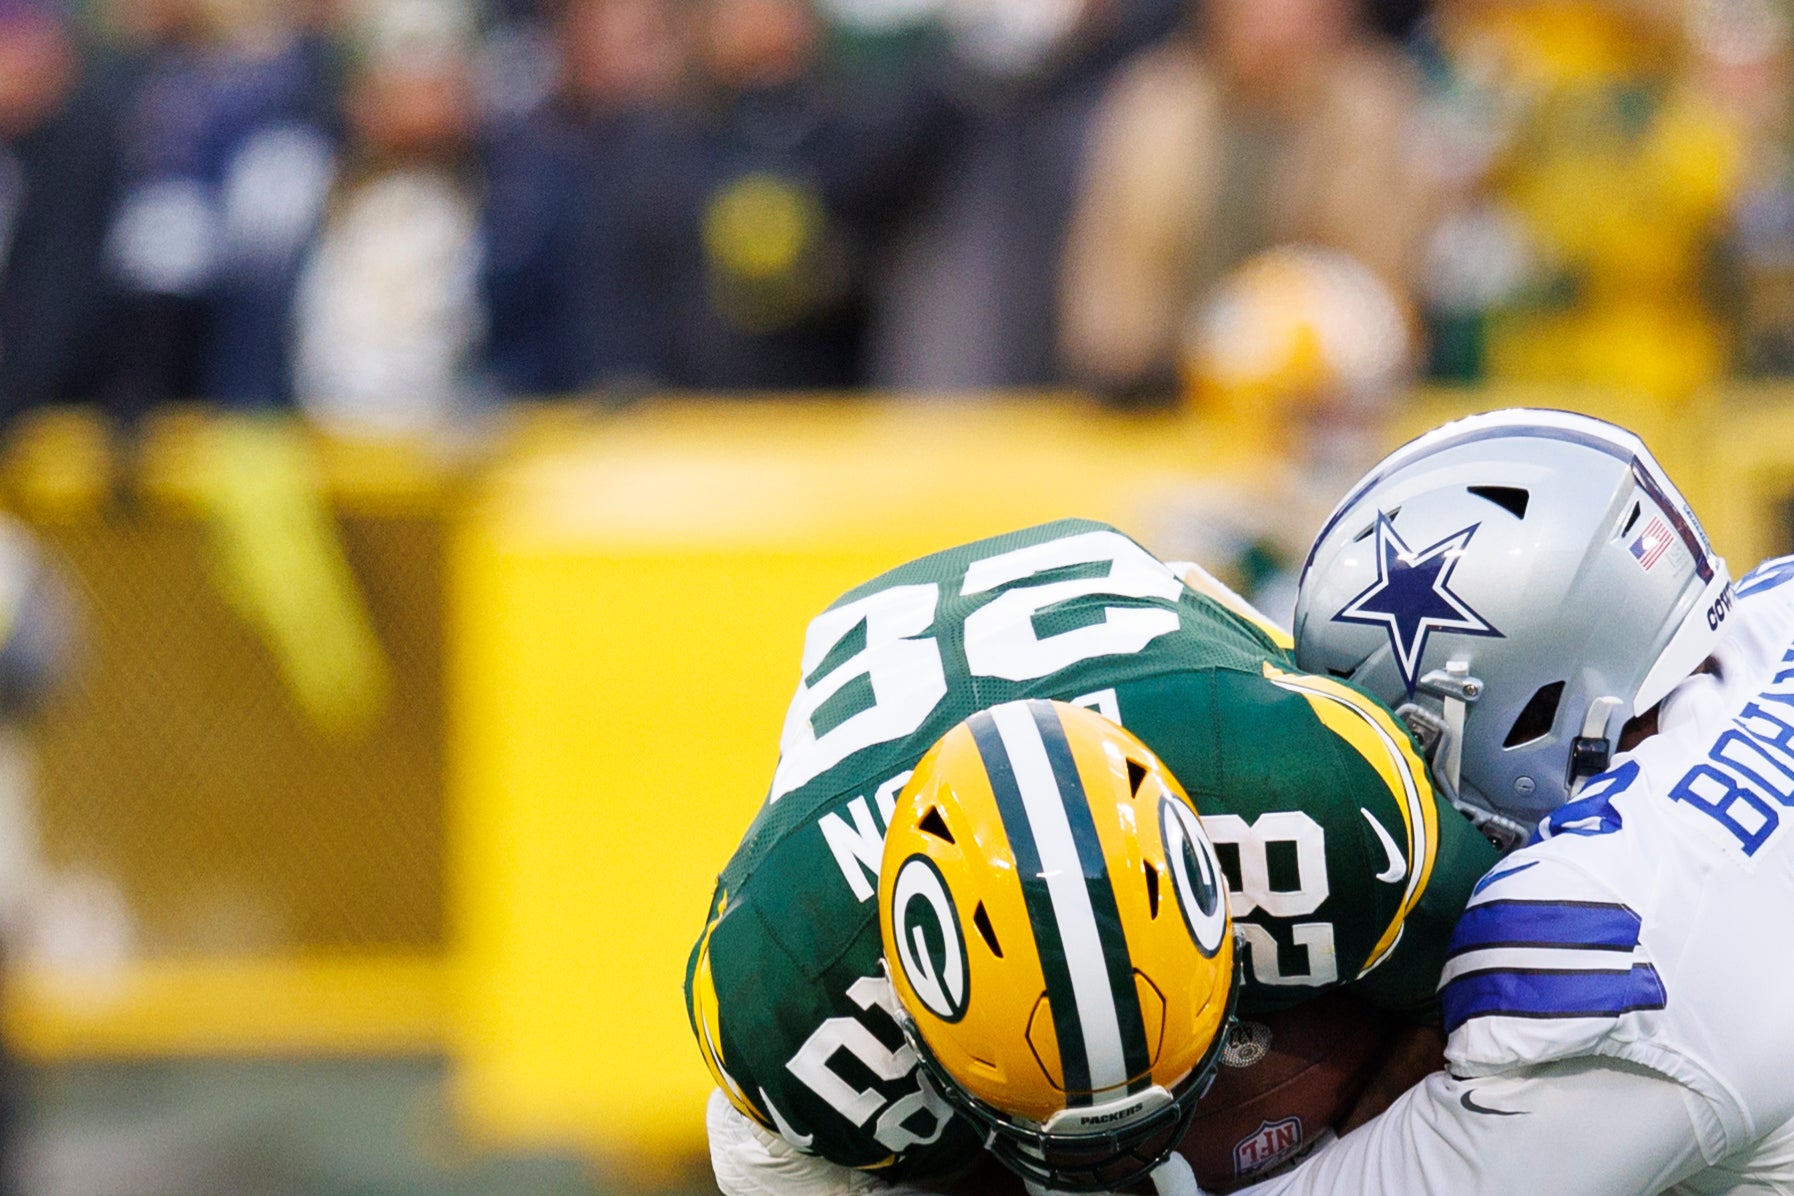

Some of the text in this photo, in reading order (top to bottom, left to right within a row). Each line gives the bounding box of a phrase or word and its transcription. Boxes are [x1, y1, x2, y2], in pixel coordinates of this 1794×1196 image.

[770, 530, 1184, 804] 28
[1080, 1102, 1144, 1126] PACKERS
[1241, 1123, 1296, 1163] NFL
